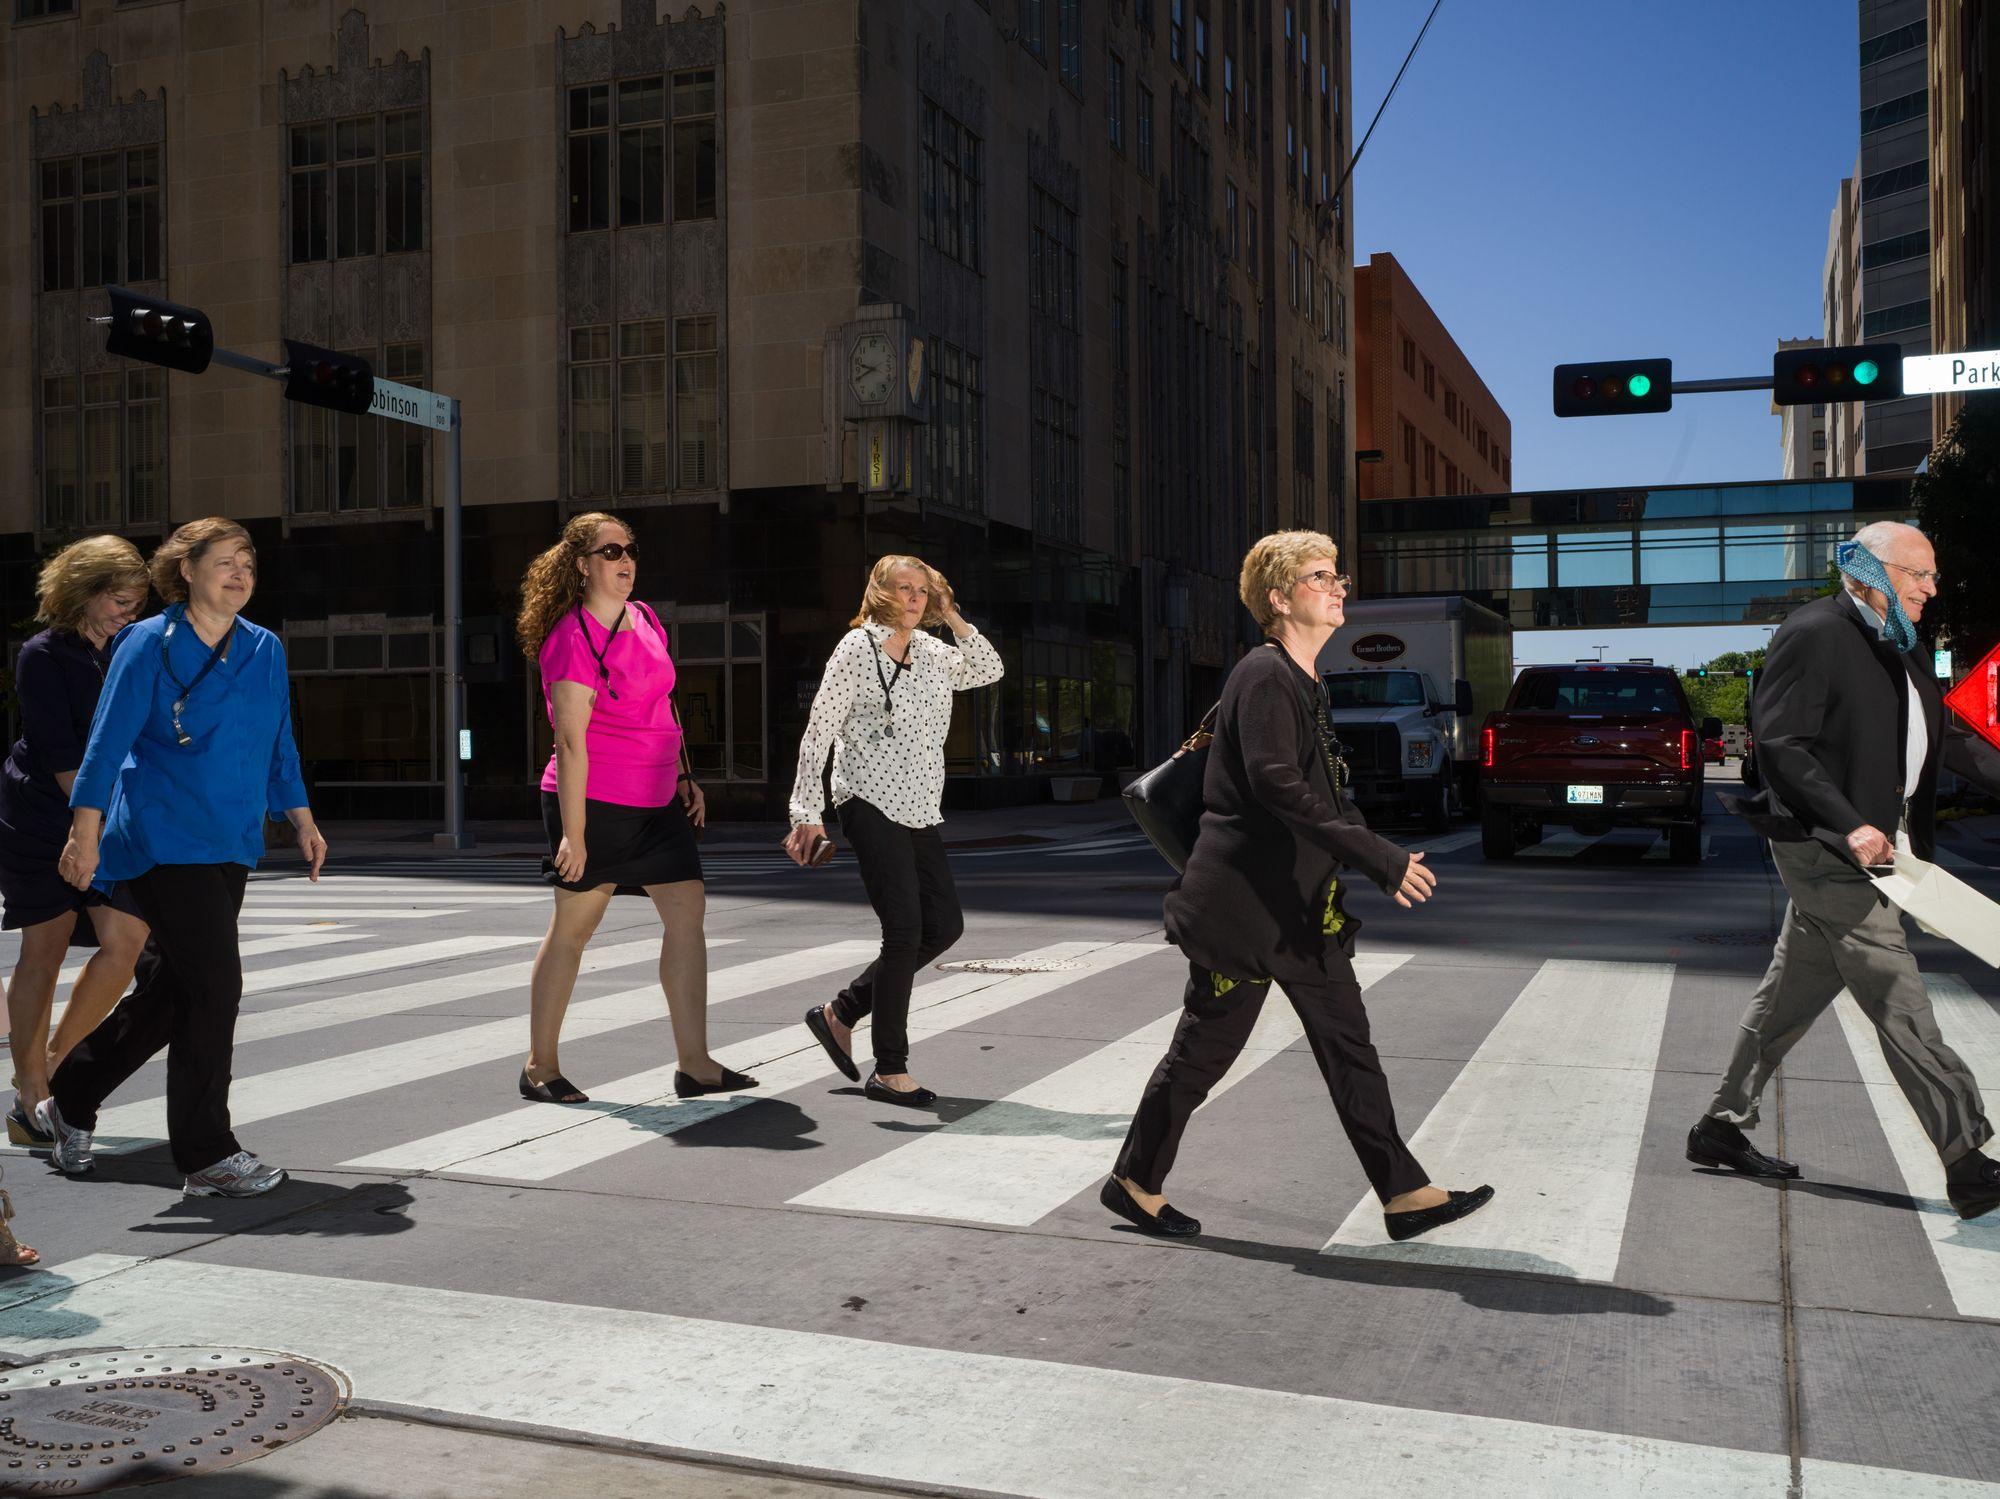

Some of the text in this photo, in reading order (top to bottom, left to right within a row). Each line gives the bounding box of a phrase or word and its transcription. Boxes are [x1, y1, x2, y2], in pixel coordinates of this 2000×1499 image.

[1953, 359, 2000, 385] Park
[372, 388, 418, 418] obinson
[436, 399, 445, 410] Ave
[873, 436, 881, 484] FIRST
[1377, 643, 1401, 652] Brothers
[47, 1408, 148, 1432] SANITARY
[81, 1400, 161, 1420] SEWER
